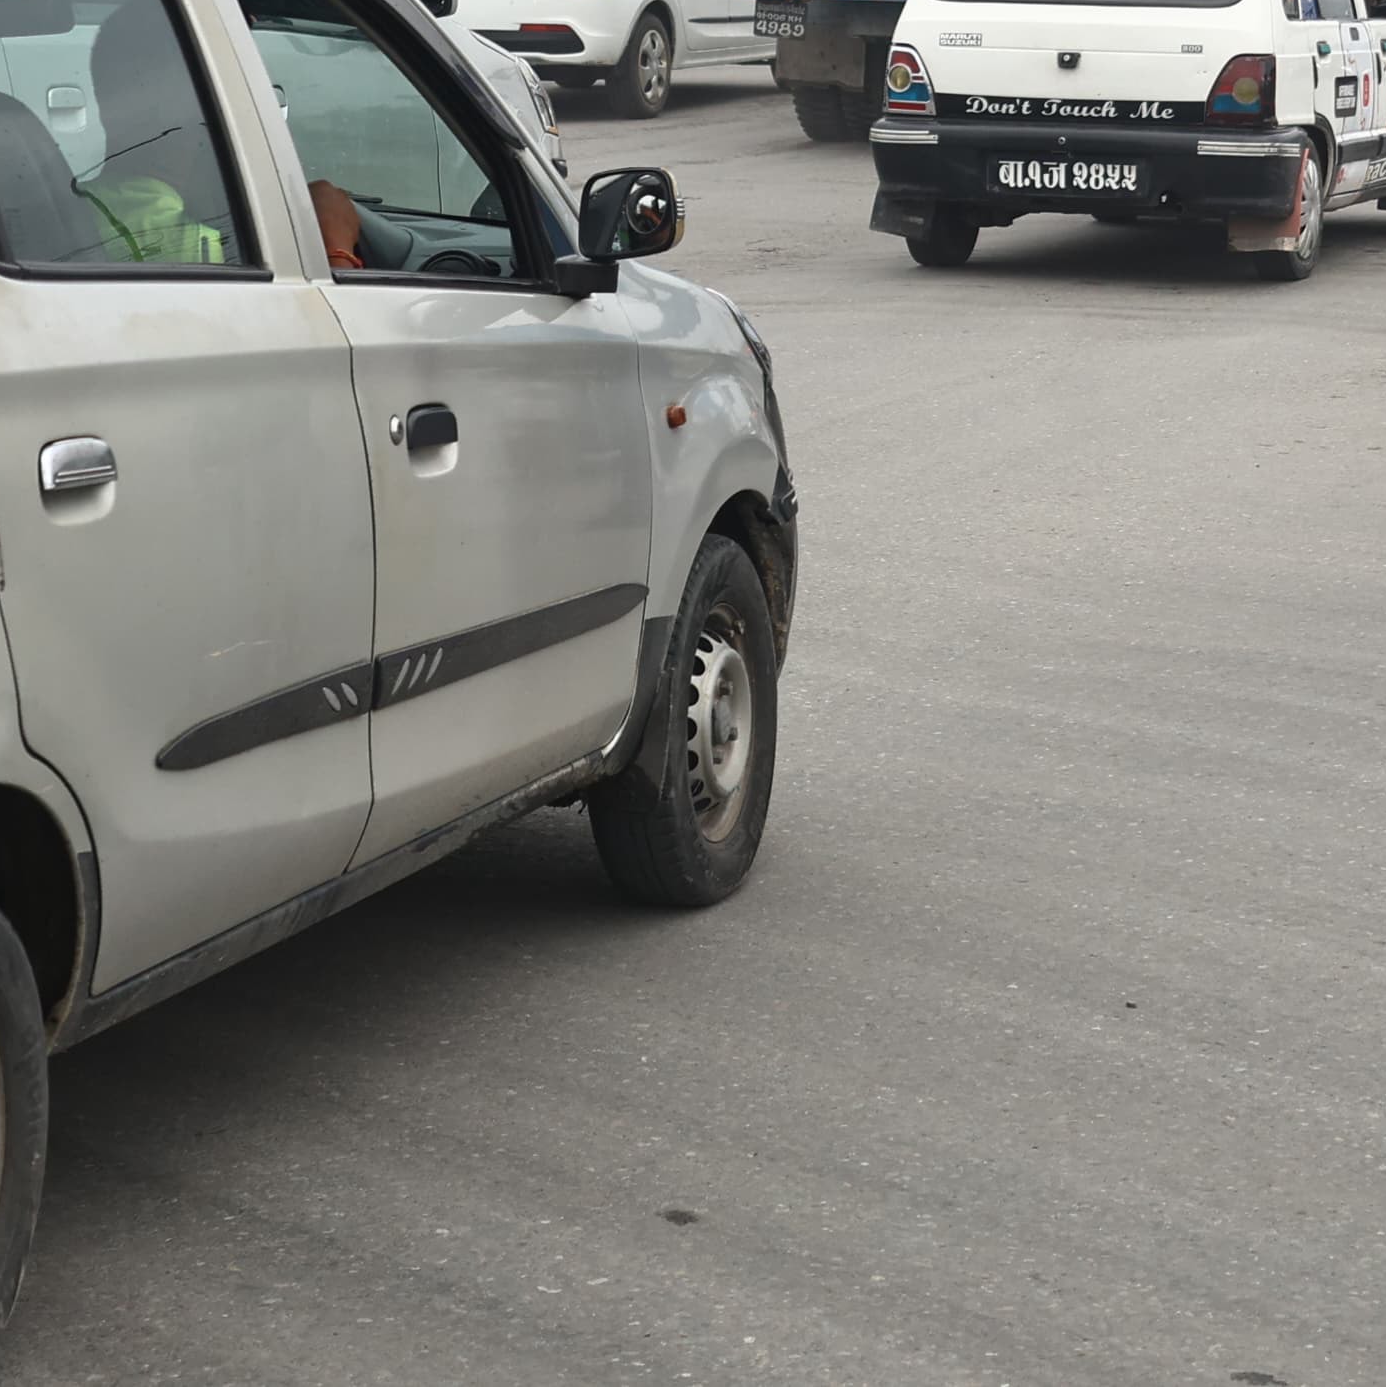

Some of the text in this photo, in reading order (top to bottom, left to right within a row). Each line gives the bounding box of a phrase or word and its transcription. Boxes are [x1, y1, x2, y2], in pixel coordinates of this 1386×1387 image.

[756, 20, 805, 37] 4989
[965, 96, 1175, 119] Don't Touch Me
